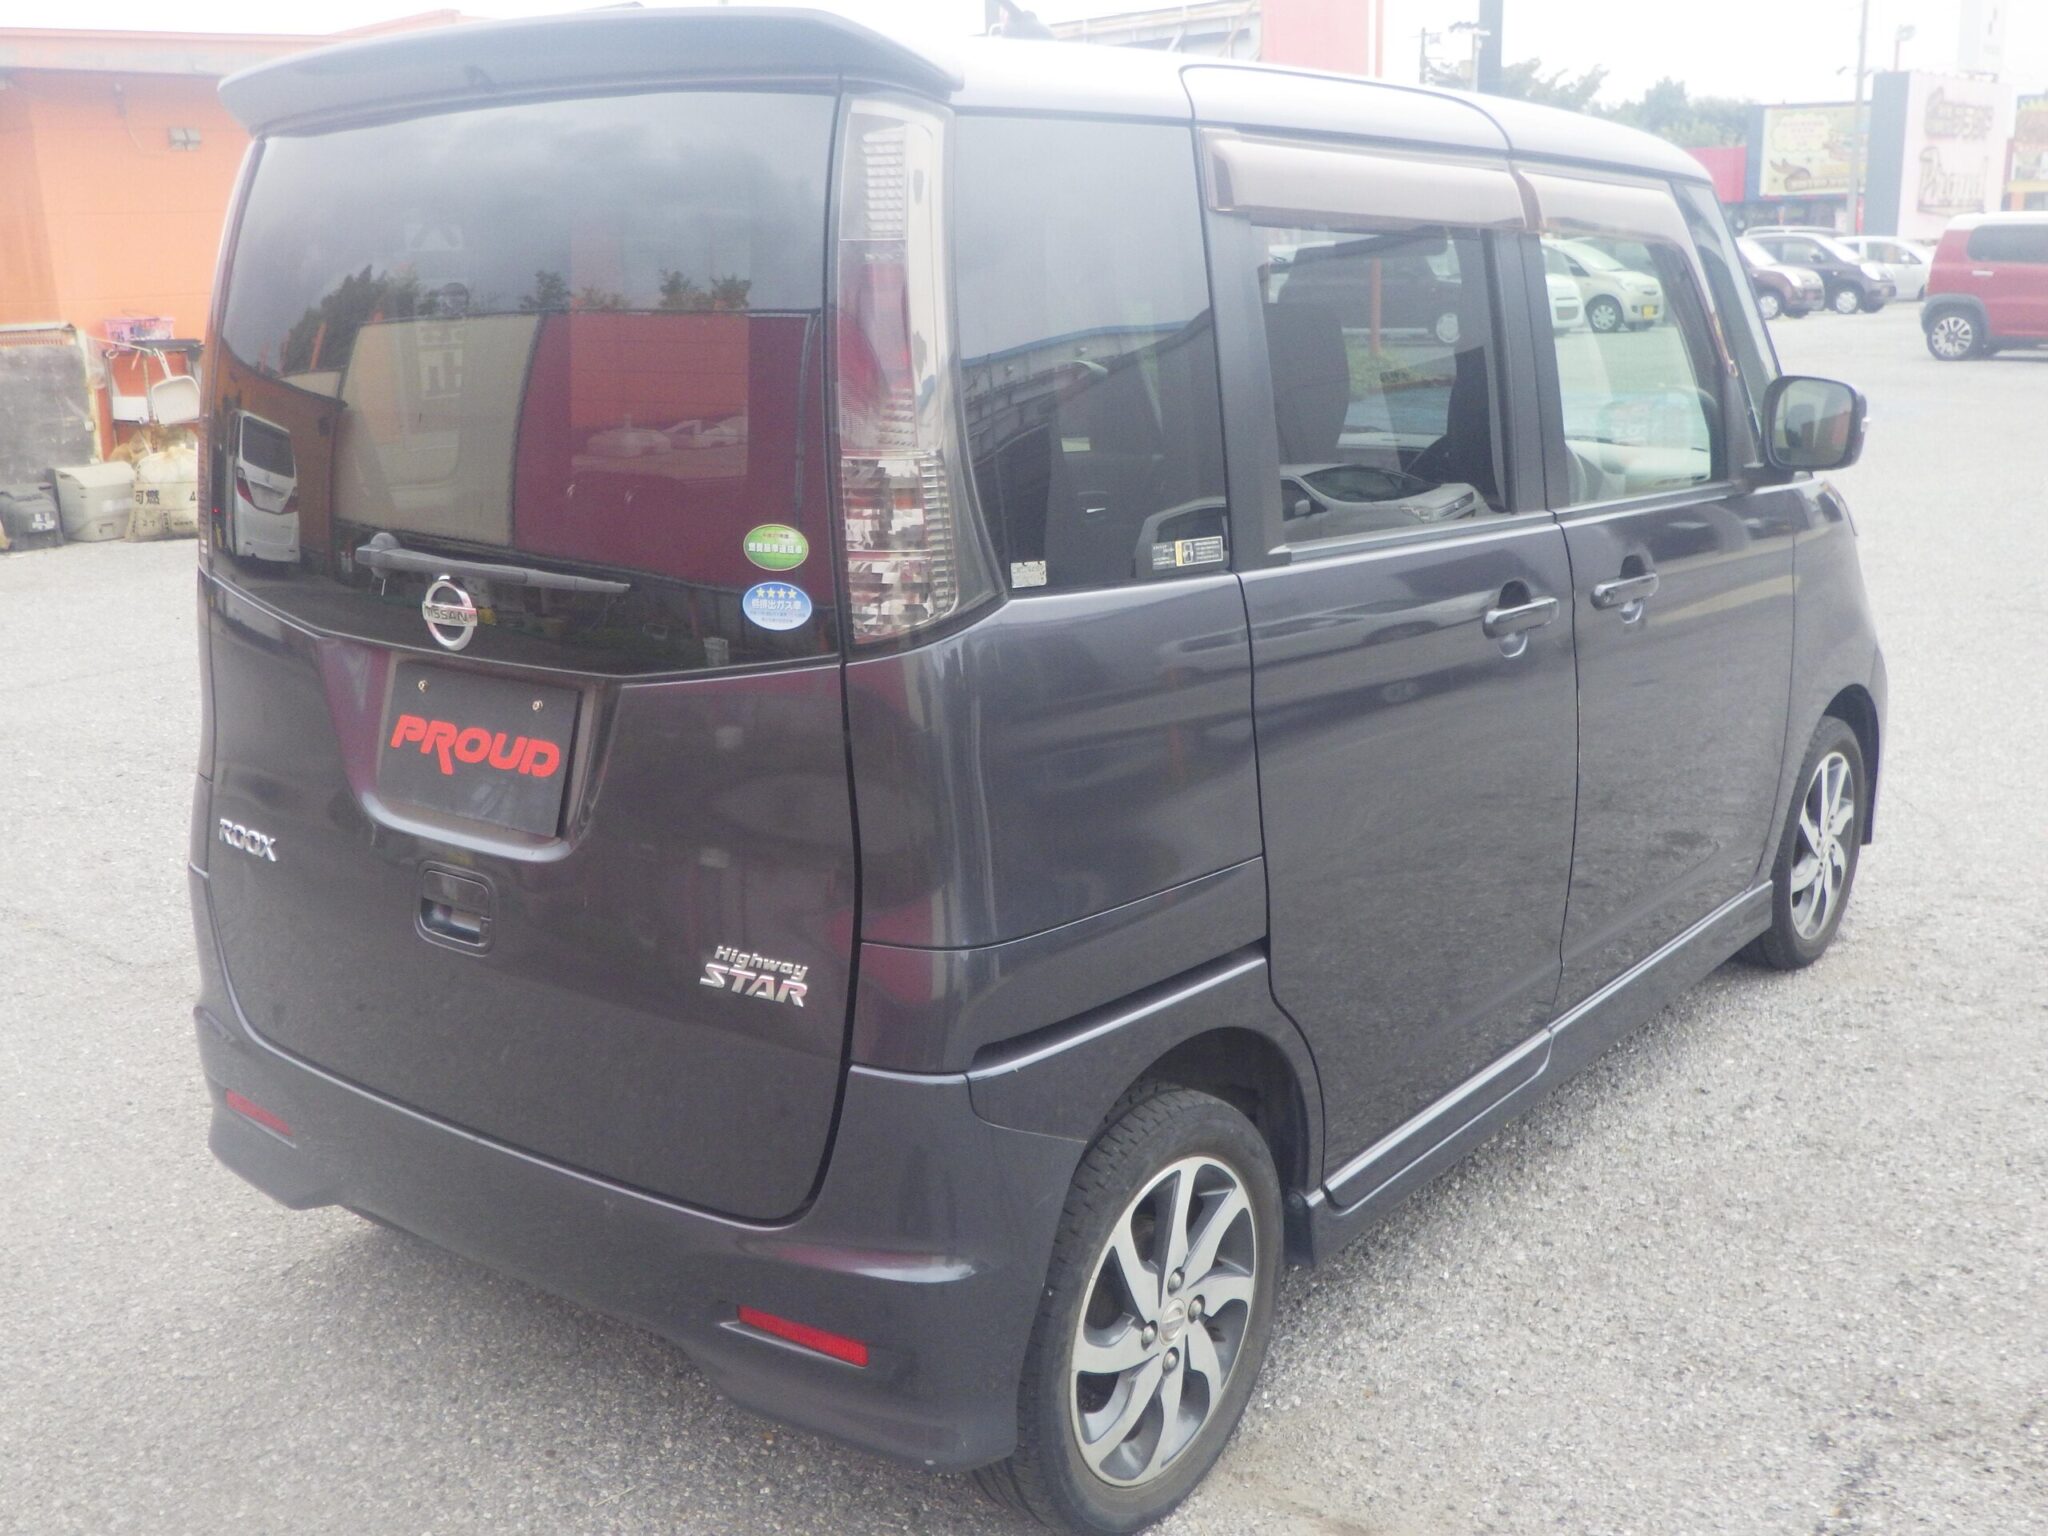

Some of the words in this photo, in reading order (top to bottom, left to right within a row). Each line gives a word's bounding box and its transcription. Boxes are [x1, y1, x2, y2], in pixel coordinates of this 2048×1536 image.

[425, 605, 468, 622] NISSAN
[390, 714, 560, 777] PROUD
[219, 818, 276, 862] ROOX
[699, 962, 808, 1007] STAR
[714, 945, 808, 982] Highway
